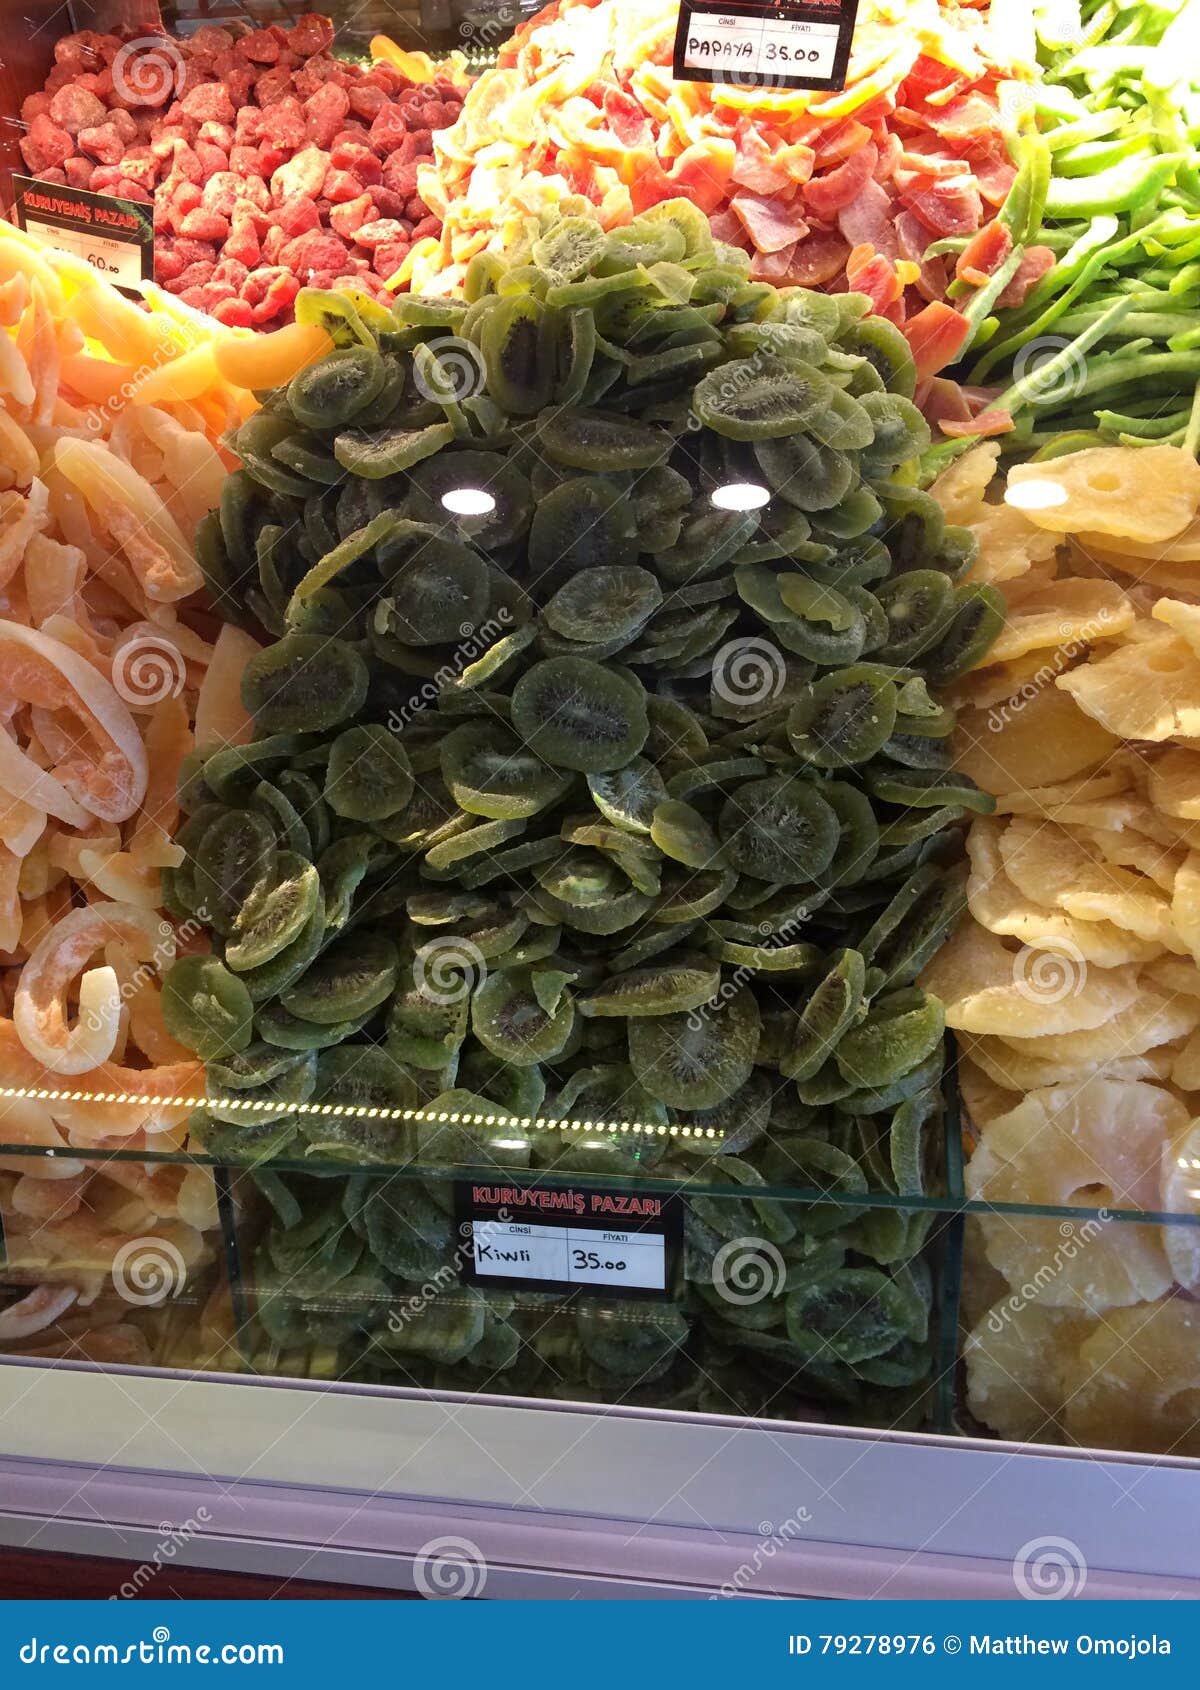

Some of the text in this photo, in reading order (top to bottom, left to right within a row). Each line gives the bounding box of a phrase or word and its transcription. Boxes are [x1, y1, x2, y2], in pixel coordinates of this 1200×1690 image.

[718, 17, 736, 26] CİNSİ
[791, 24, 812, 33] FİYATI
[688, 37, 753, 58] PAPAYA
[765, 43, 820, 62] 35.00
[24, 192, 92, 223] KURUYEMİŞ
[473, 1187, 661, 1215] KURUYEMİŞ PAZARI
[509, 1225, 532, 1234] CİNSİ
[603, 1233, 629, 1242] FİYATI
[572, 1250, 627, 1270] 35.00
